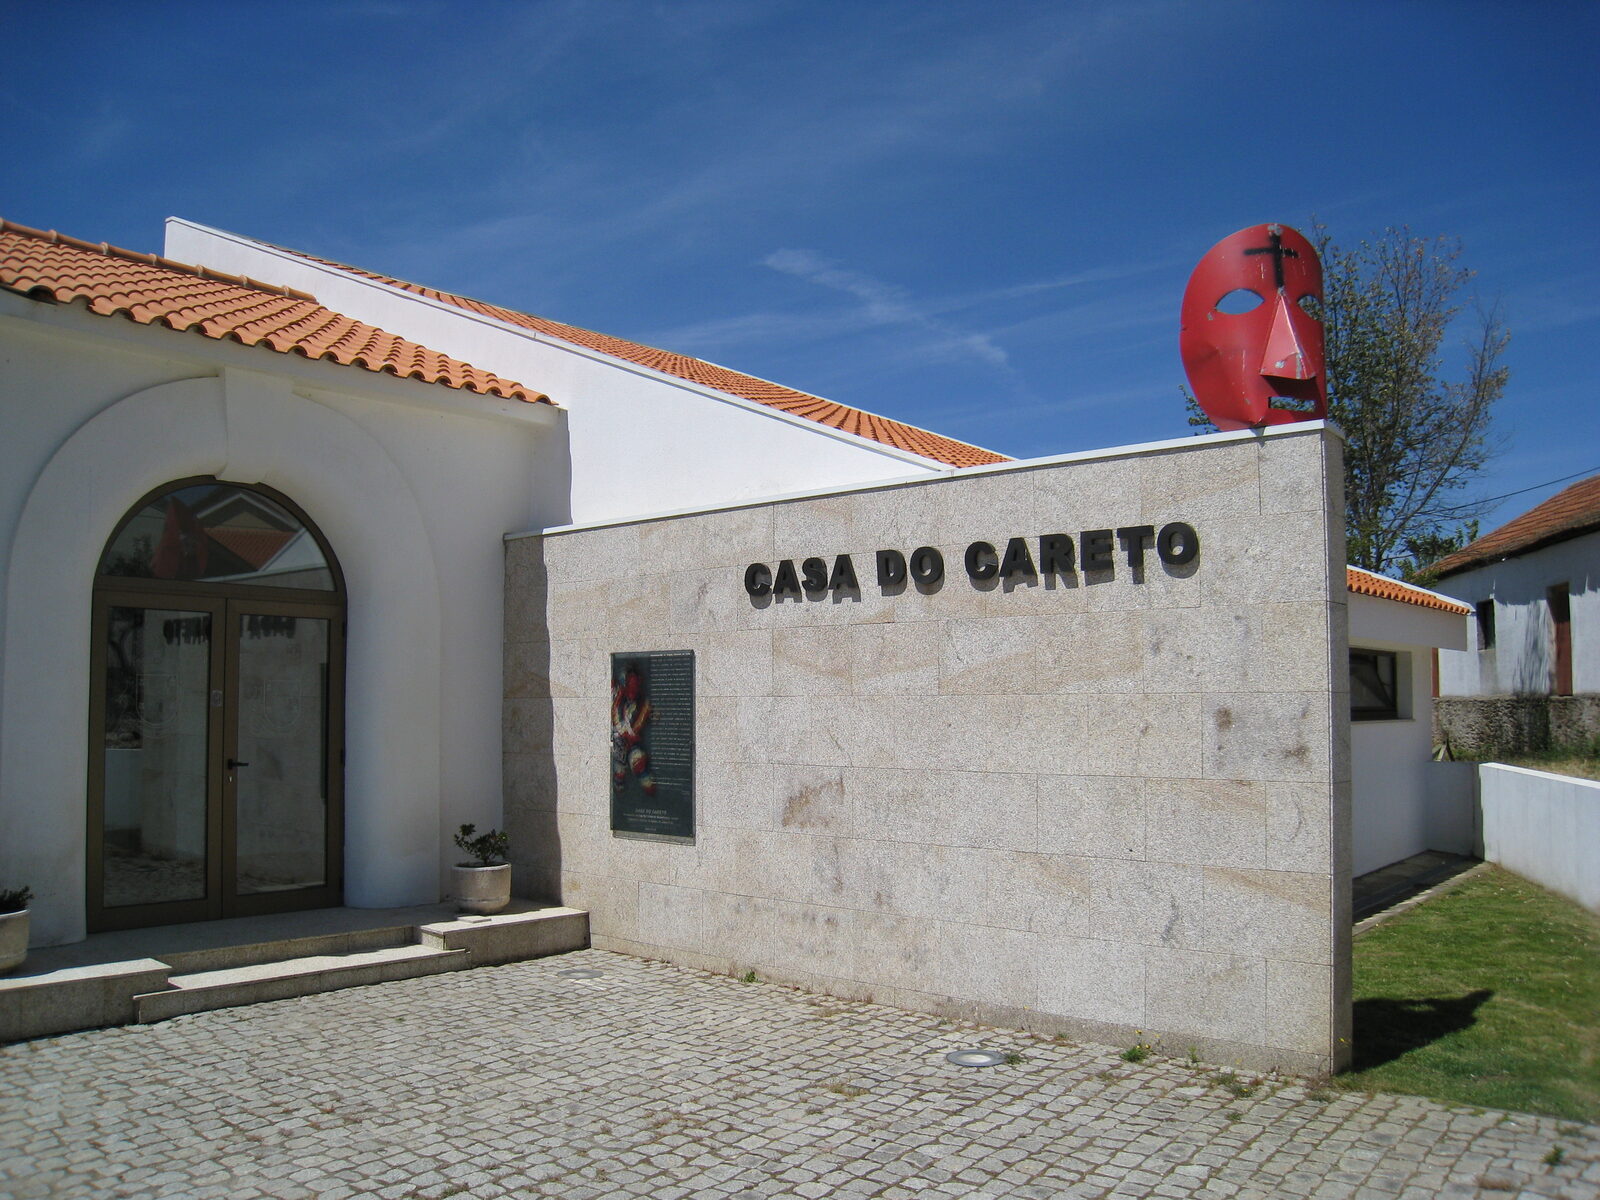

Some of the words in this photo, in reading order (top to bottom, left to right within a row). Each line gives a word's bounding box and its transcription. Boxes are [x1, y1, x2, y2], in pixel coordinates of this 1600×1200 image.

[745, 553, 861, 597] CASA
[876, 546, 944, 586] DO
[965, 522, 1199, 580] CARETO
